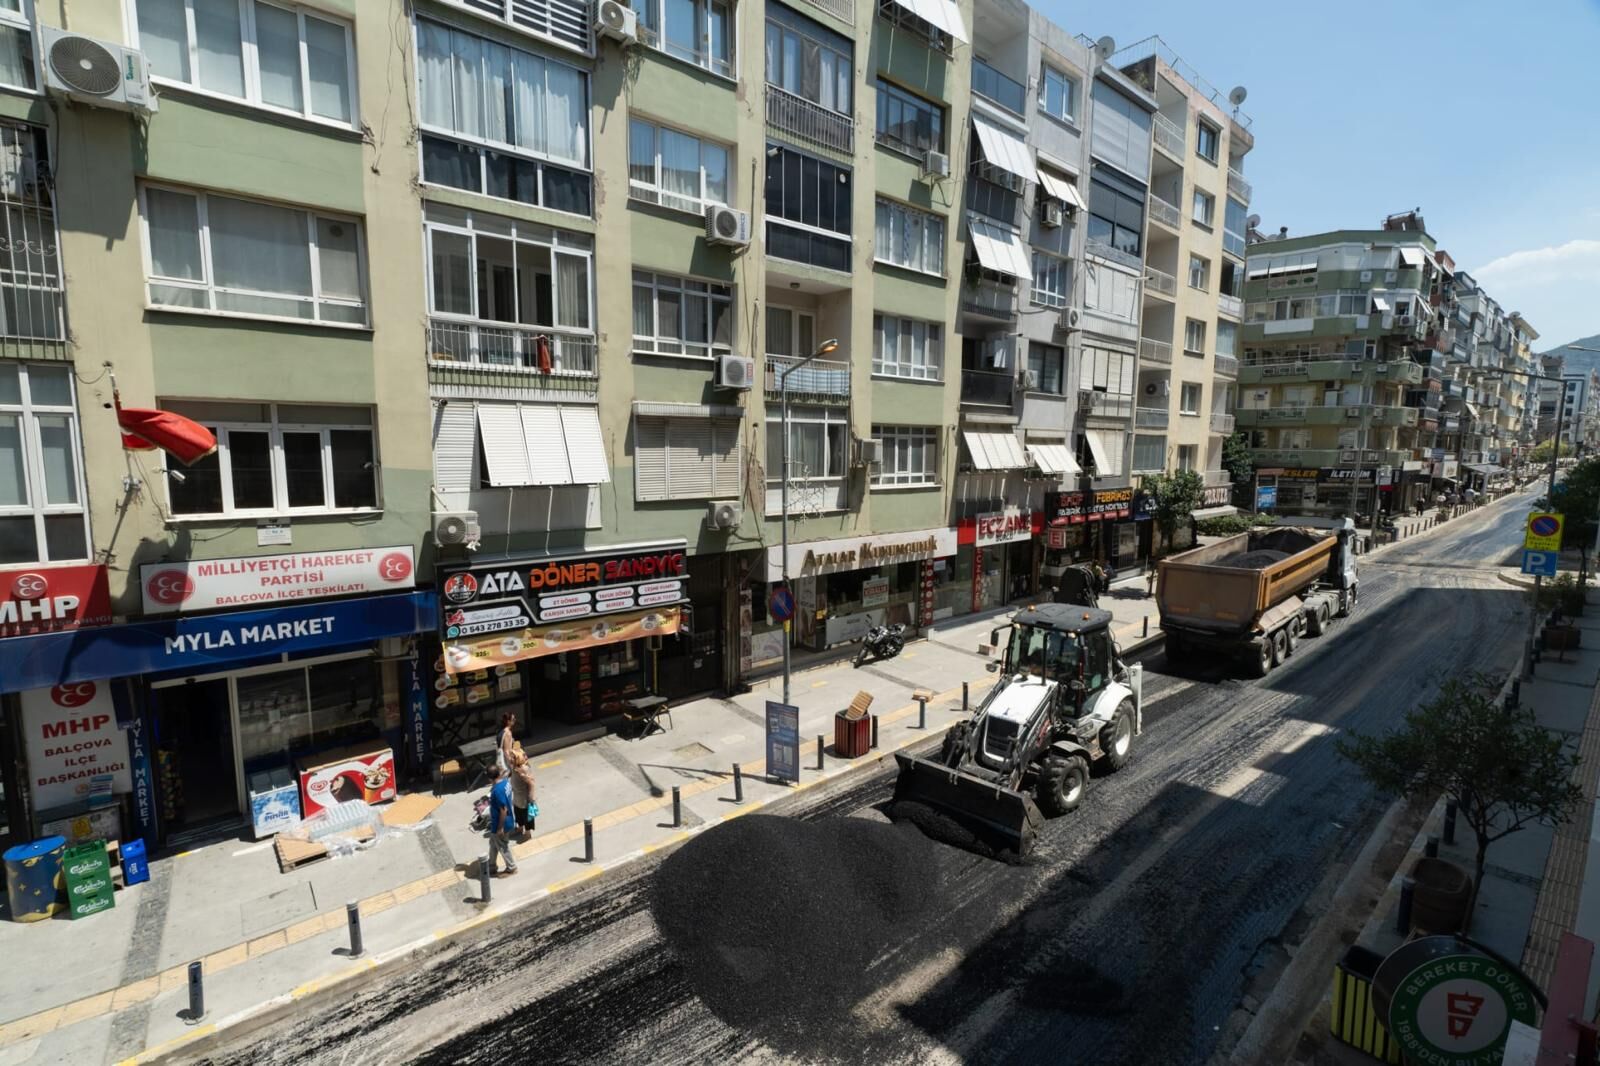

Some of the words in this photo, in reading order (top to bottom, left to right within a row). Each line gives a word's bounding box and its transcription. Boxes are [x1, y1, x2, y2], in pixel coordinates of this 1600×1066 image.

[197, 555, 297, 577] MİLLİYETÇİ
[301, 552, 375, 569] HAREKET
[480, 570, 525, 594] ATA
[530, 561, 601, 588] DÖNER
[604, 551, 683, 580] SANDVİÇ
[1526, 552, 1547, 573] P
[260, 571, 324, 587] PARTİSİ
[215, 592, 274, 606] BALÇOVA
[277, 588, 305, 600] İLÇE
[306, 583, 365, 596] TEŞKİLATI
[0, 595, 80, 625] MHP
[164, 629, 236, 655] MYLA
[240, 616, 336, 645] MARKET
[469, 624, 485, 633] 543
[487, 622, 500, 630] 278
[503, 620, 514, 628] 33
[515, 618, 525, 626] 35
[42, 714, 111, 739] MHP
[132, 717, 144, 757] MYLA
[413, 701, 424, 763] MARKET
[44, 738, 112, 758] BALÇOVA
[64, 754, 97, 768] İLÇE
[37, 762, 125, 787] BAŞKANLIĞI
[135, 767, 150, 827] MARKET
[1406, 961, 1480, 996] BEREKET
[1485, 967, 1528, 1012] DÖNER
